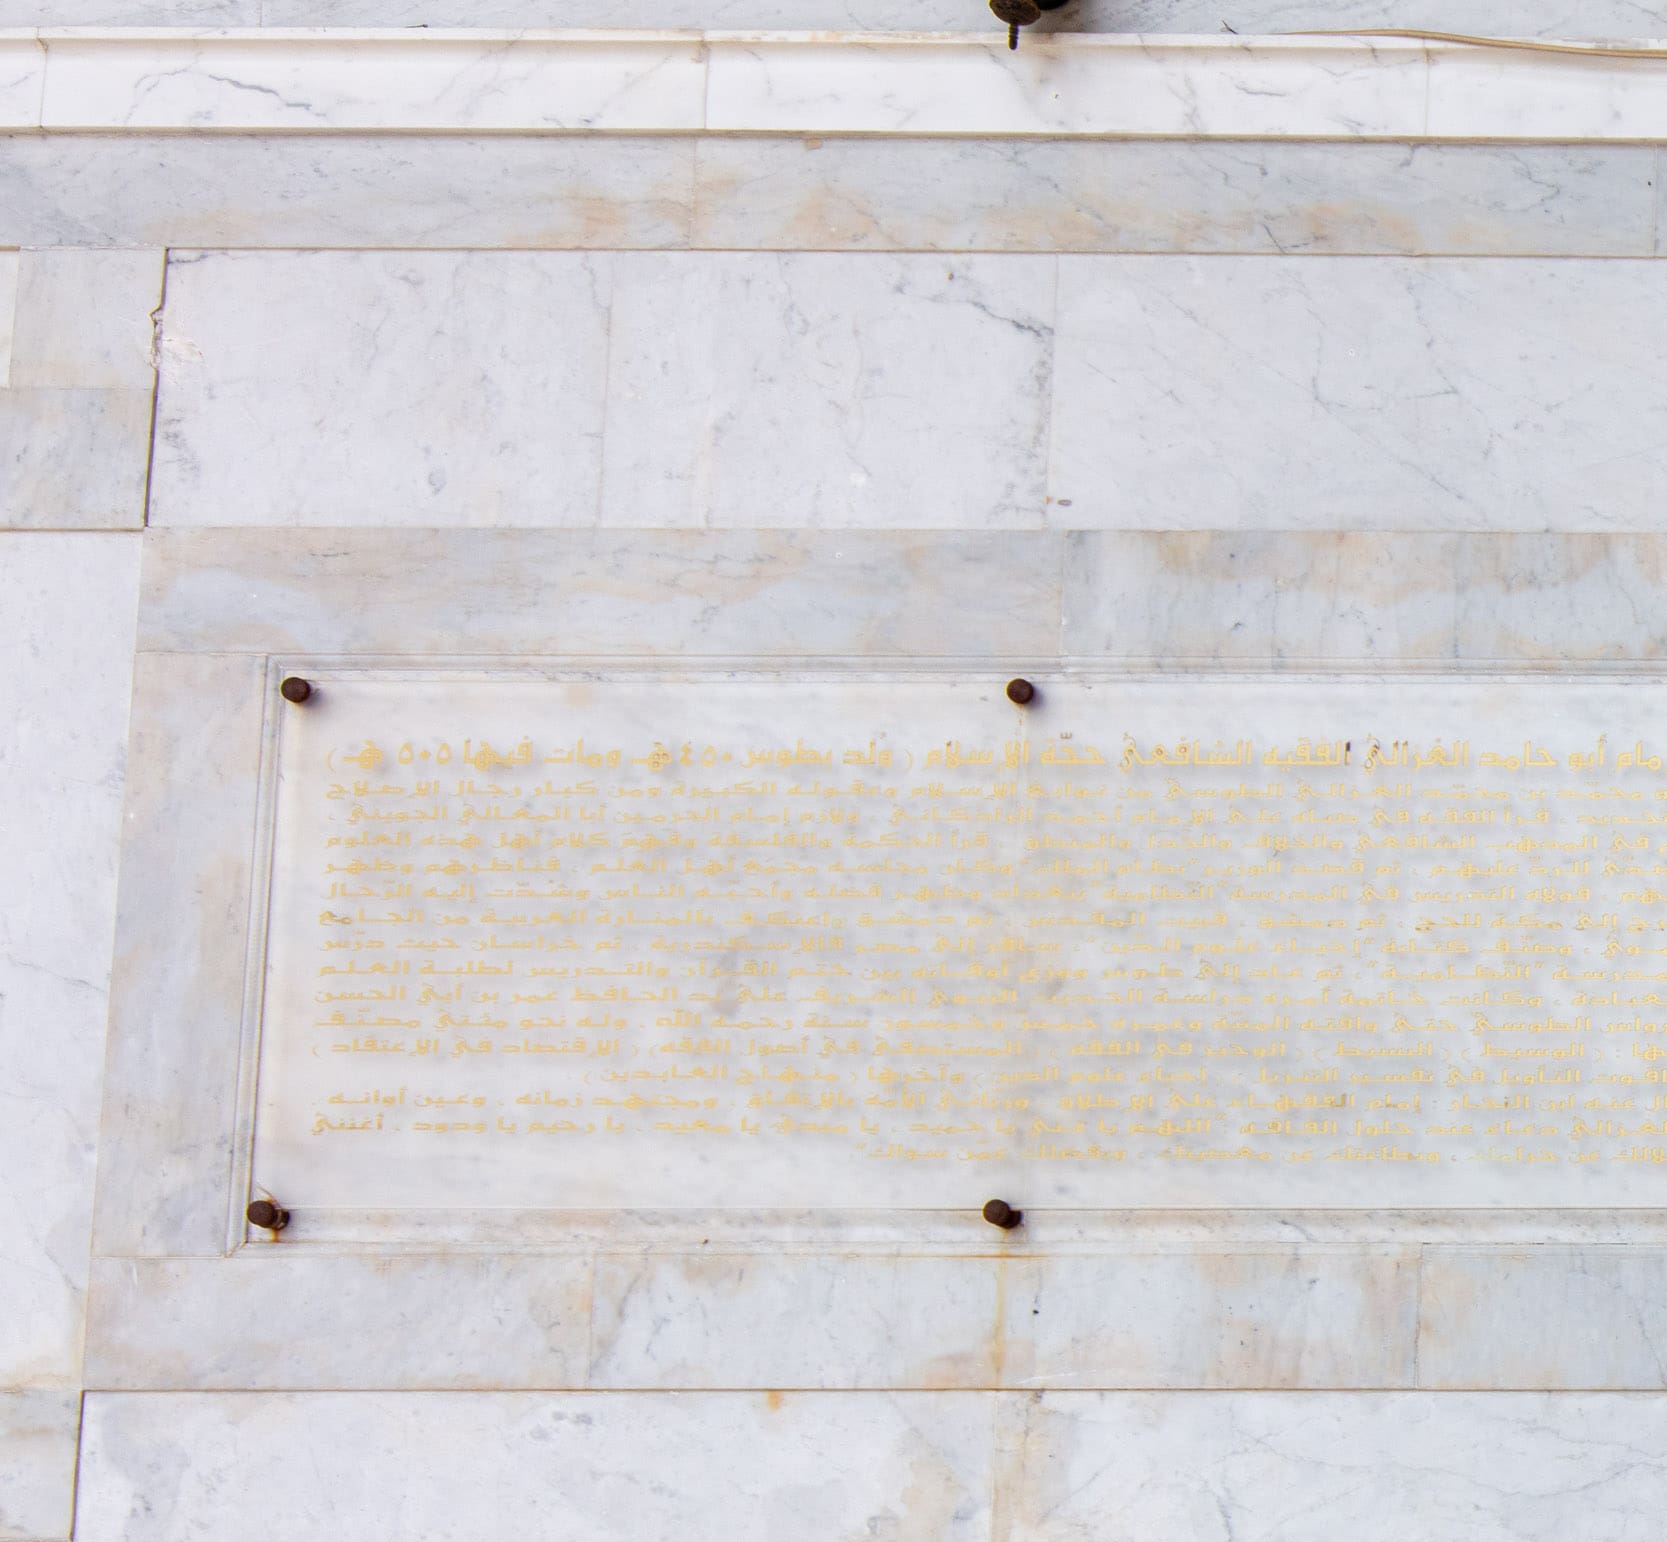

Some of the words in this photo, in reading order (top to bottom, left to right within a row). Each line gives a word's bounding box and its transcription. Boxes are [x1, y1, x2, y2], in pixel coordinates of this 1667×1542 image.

[398, 742, 451, 765] ٥٠٥
[463, 737, 532, 771] فيها
[544, 738, 621, 768] ومات
[679, 743, 732, 767] ٤٥٠
[744, 739, 832, 768] بطوس
[926, 740, 1030, 771] الإسلام
[1119, 739, 1252, 774] الشافعي
[1262, 739, 1350, 771] الفقيه
[1363, 740, 1469, 774] الغزالي
[1479, 741, 1557, 771] حامد
[1568, 736, 1608, 771] أبو
